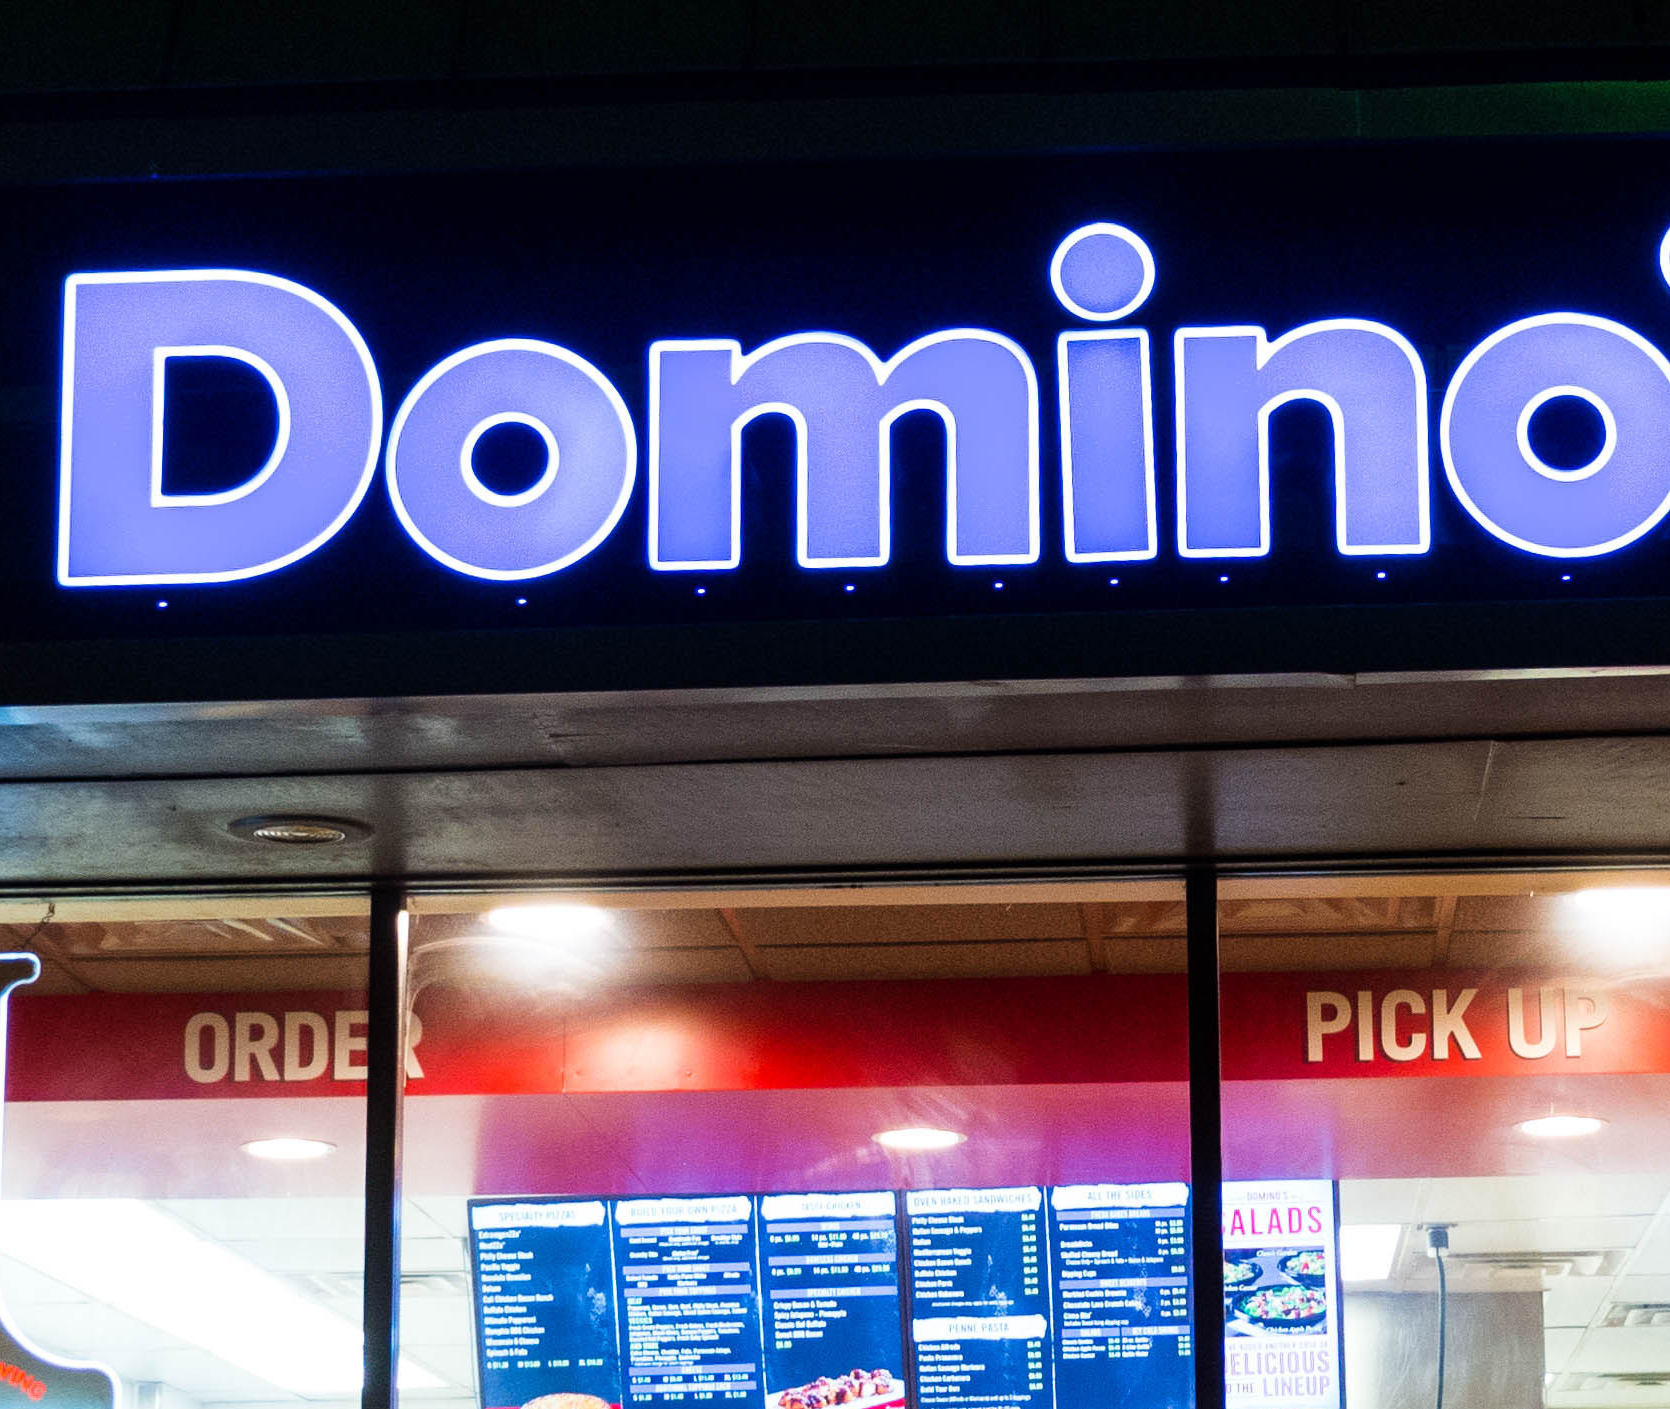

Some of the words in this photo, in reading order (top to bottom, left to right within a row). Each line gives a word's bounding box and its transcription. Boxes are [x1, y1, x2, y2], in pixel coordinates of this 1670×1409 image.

[1306, 988, 1482, 1062] PICK
[1507, 987, 1610, 1060] UP
[913, 1196, 937, 1207] OVEN
[973, 1193, 1033, 1205] SANDWICHES
[1087, 1191, 1102, 1201] ALL
[1106, 1190, 1122, 1201] THE
[1125, 1189, 1153, 1200] SIDES
[687, 1204, 708, 1215] OWN
[1222, 1205, 1323, 1236] ALADS
[949, 1323, 977, 1333] PENNE
[981, 1322, 1009, 1333] PASTA
[1237, 1382, 1255, 1393] THE
[1263, 1375, 1331, 1397] LINEUP
